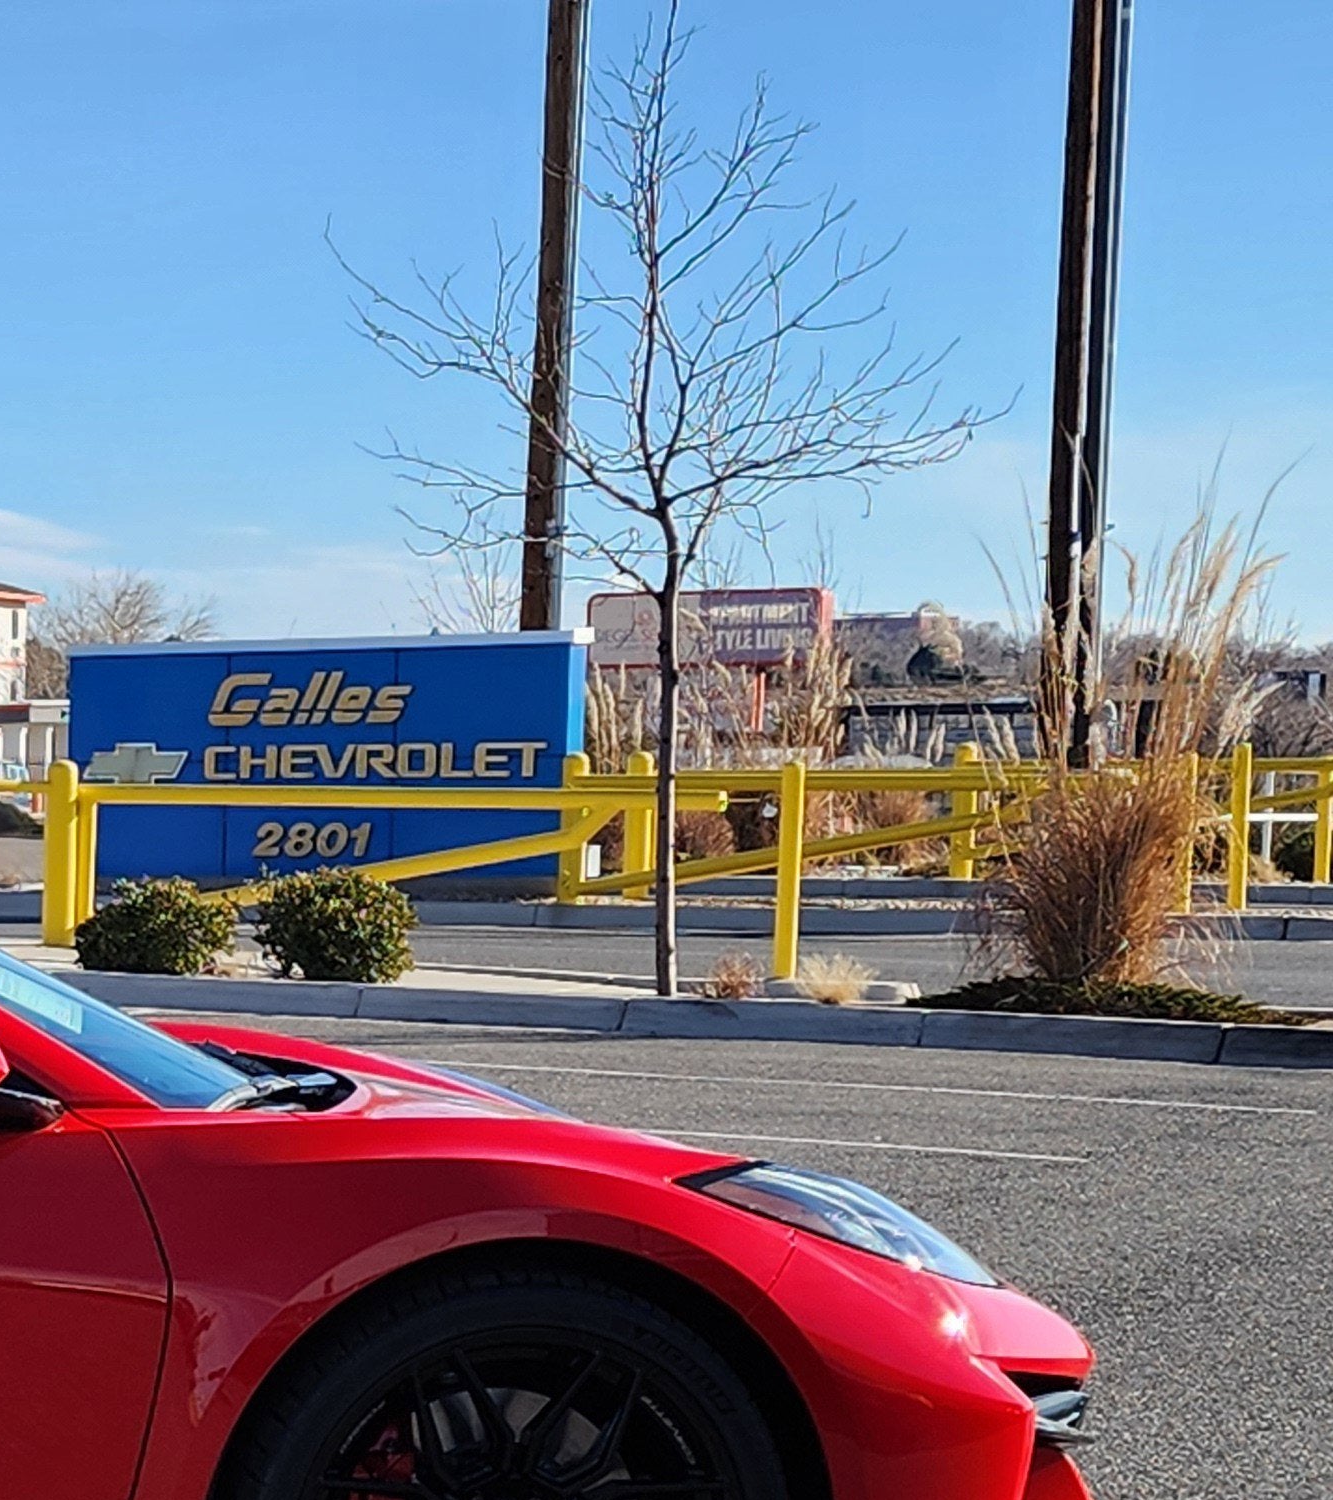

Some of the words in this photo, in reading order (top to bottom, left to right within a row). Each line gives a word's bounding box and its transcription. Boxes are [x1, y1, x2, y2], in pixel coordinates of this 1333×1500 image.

[208, 671, 413, 727] Galles
[203, 741, 549, 781] CHEVROLET
[252, 822, 373, 858] 2801
